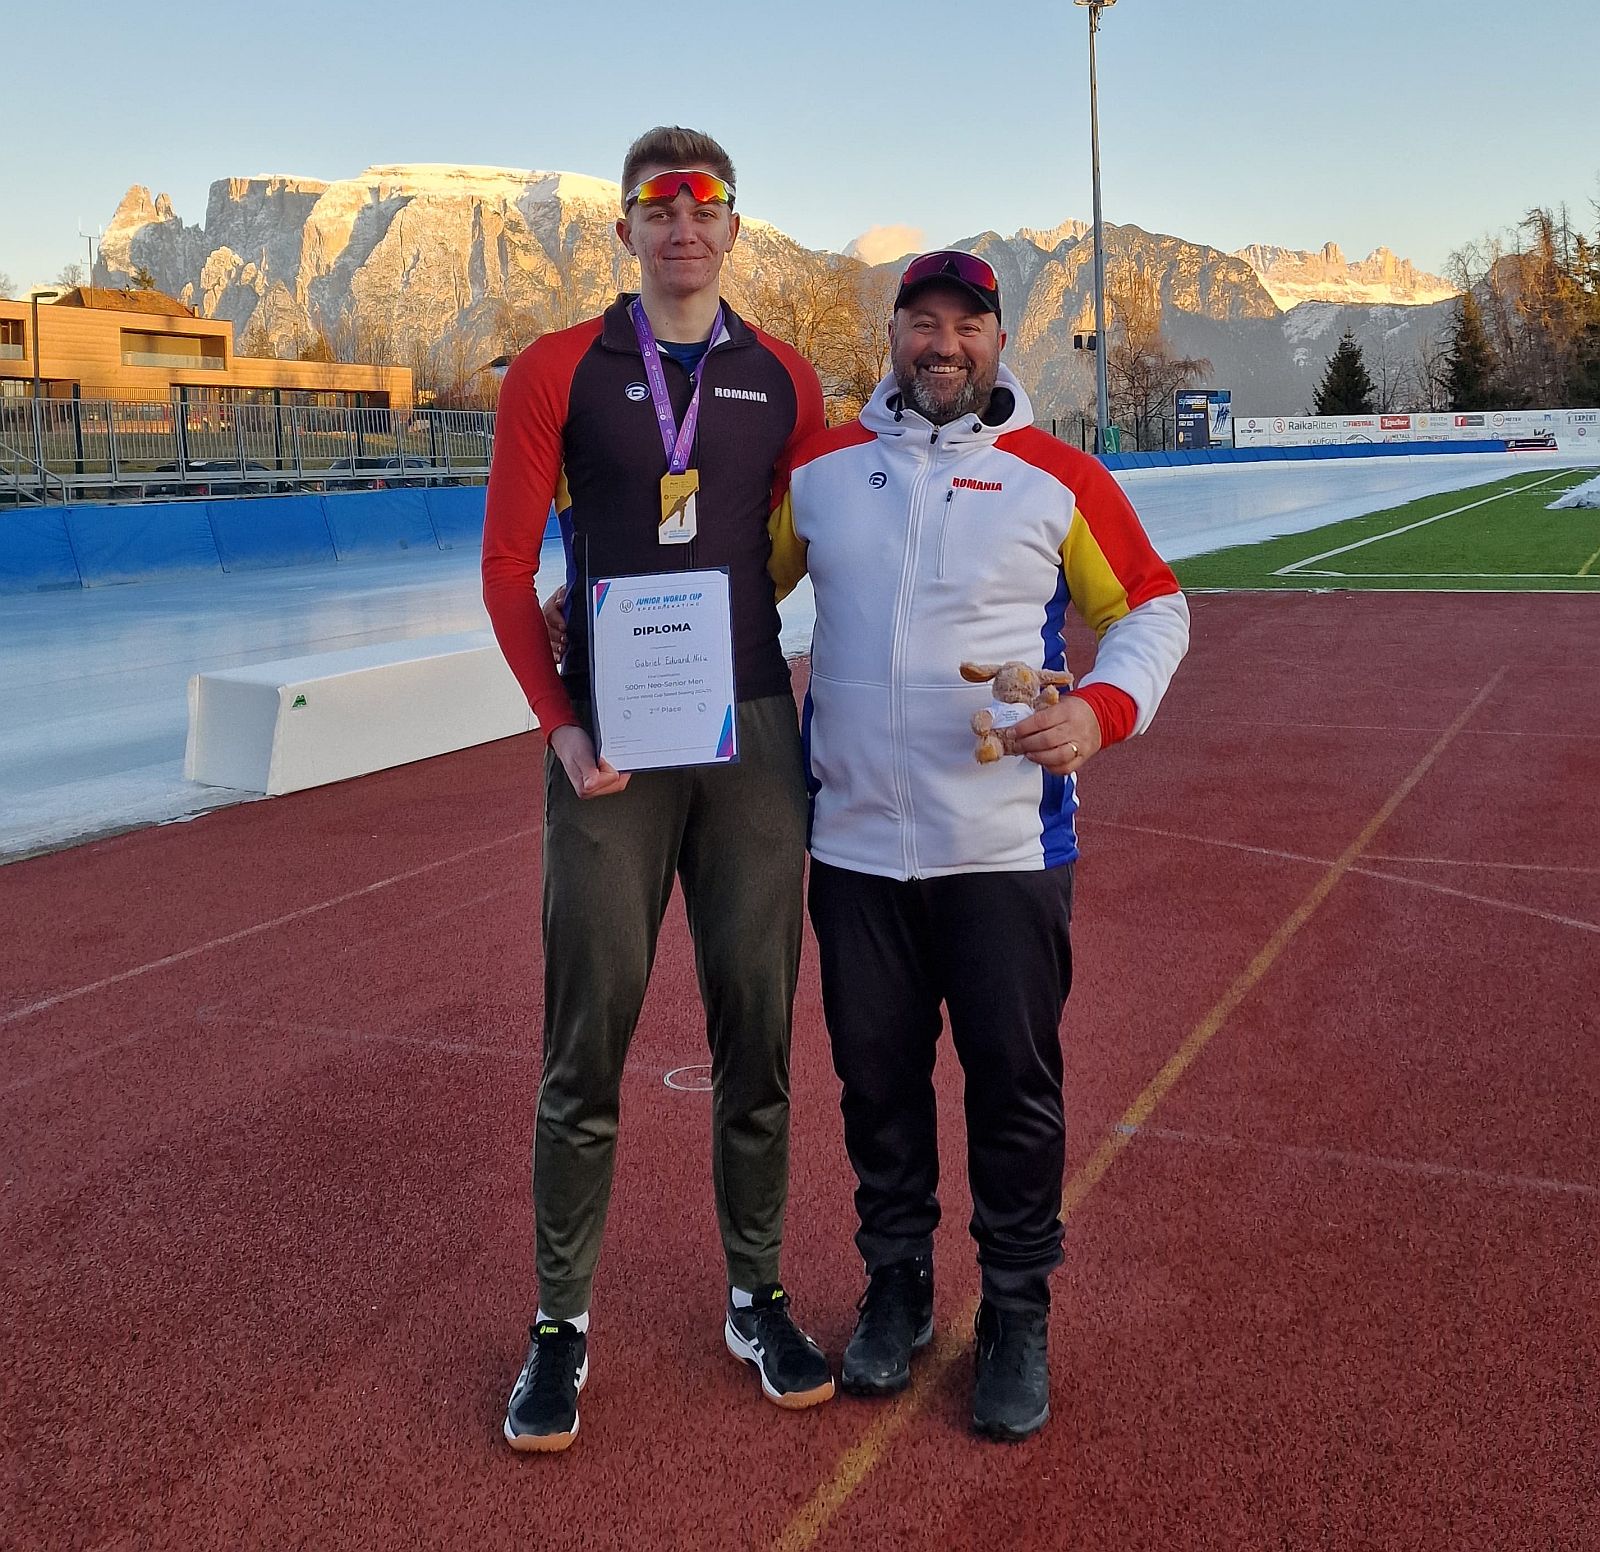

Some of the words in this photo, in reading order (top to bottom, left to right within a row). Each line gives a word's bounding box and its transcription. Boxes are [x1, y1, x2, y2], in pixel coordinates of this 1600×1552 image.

[715, 387, 768, 403] ROMANIA
[1288, 420, 1338, 431] RaikaRitten
[952, 477, 1003, 491] ROMANIA
[636, 597, 661, 606] JUNIOR
[663, 594, 688, 603] WORLD
[689, 592, 703, 600] CUP
[633, 622, 692, 636] DIPLOMA
[634, 657, 662, 668] Gabriel
[624, 683, 646, 691] 500m
[647, 679, 686, 690] Neo-Senior
[688, 678, 704, 686] Men
[661, 705, 682, 713] Place
